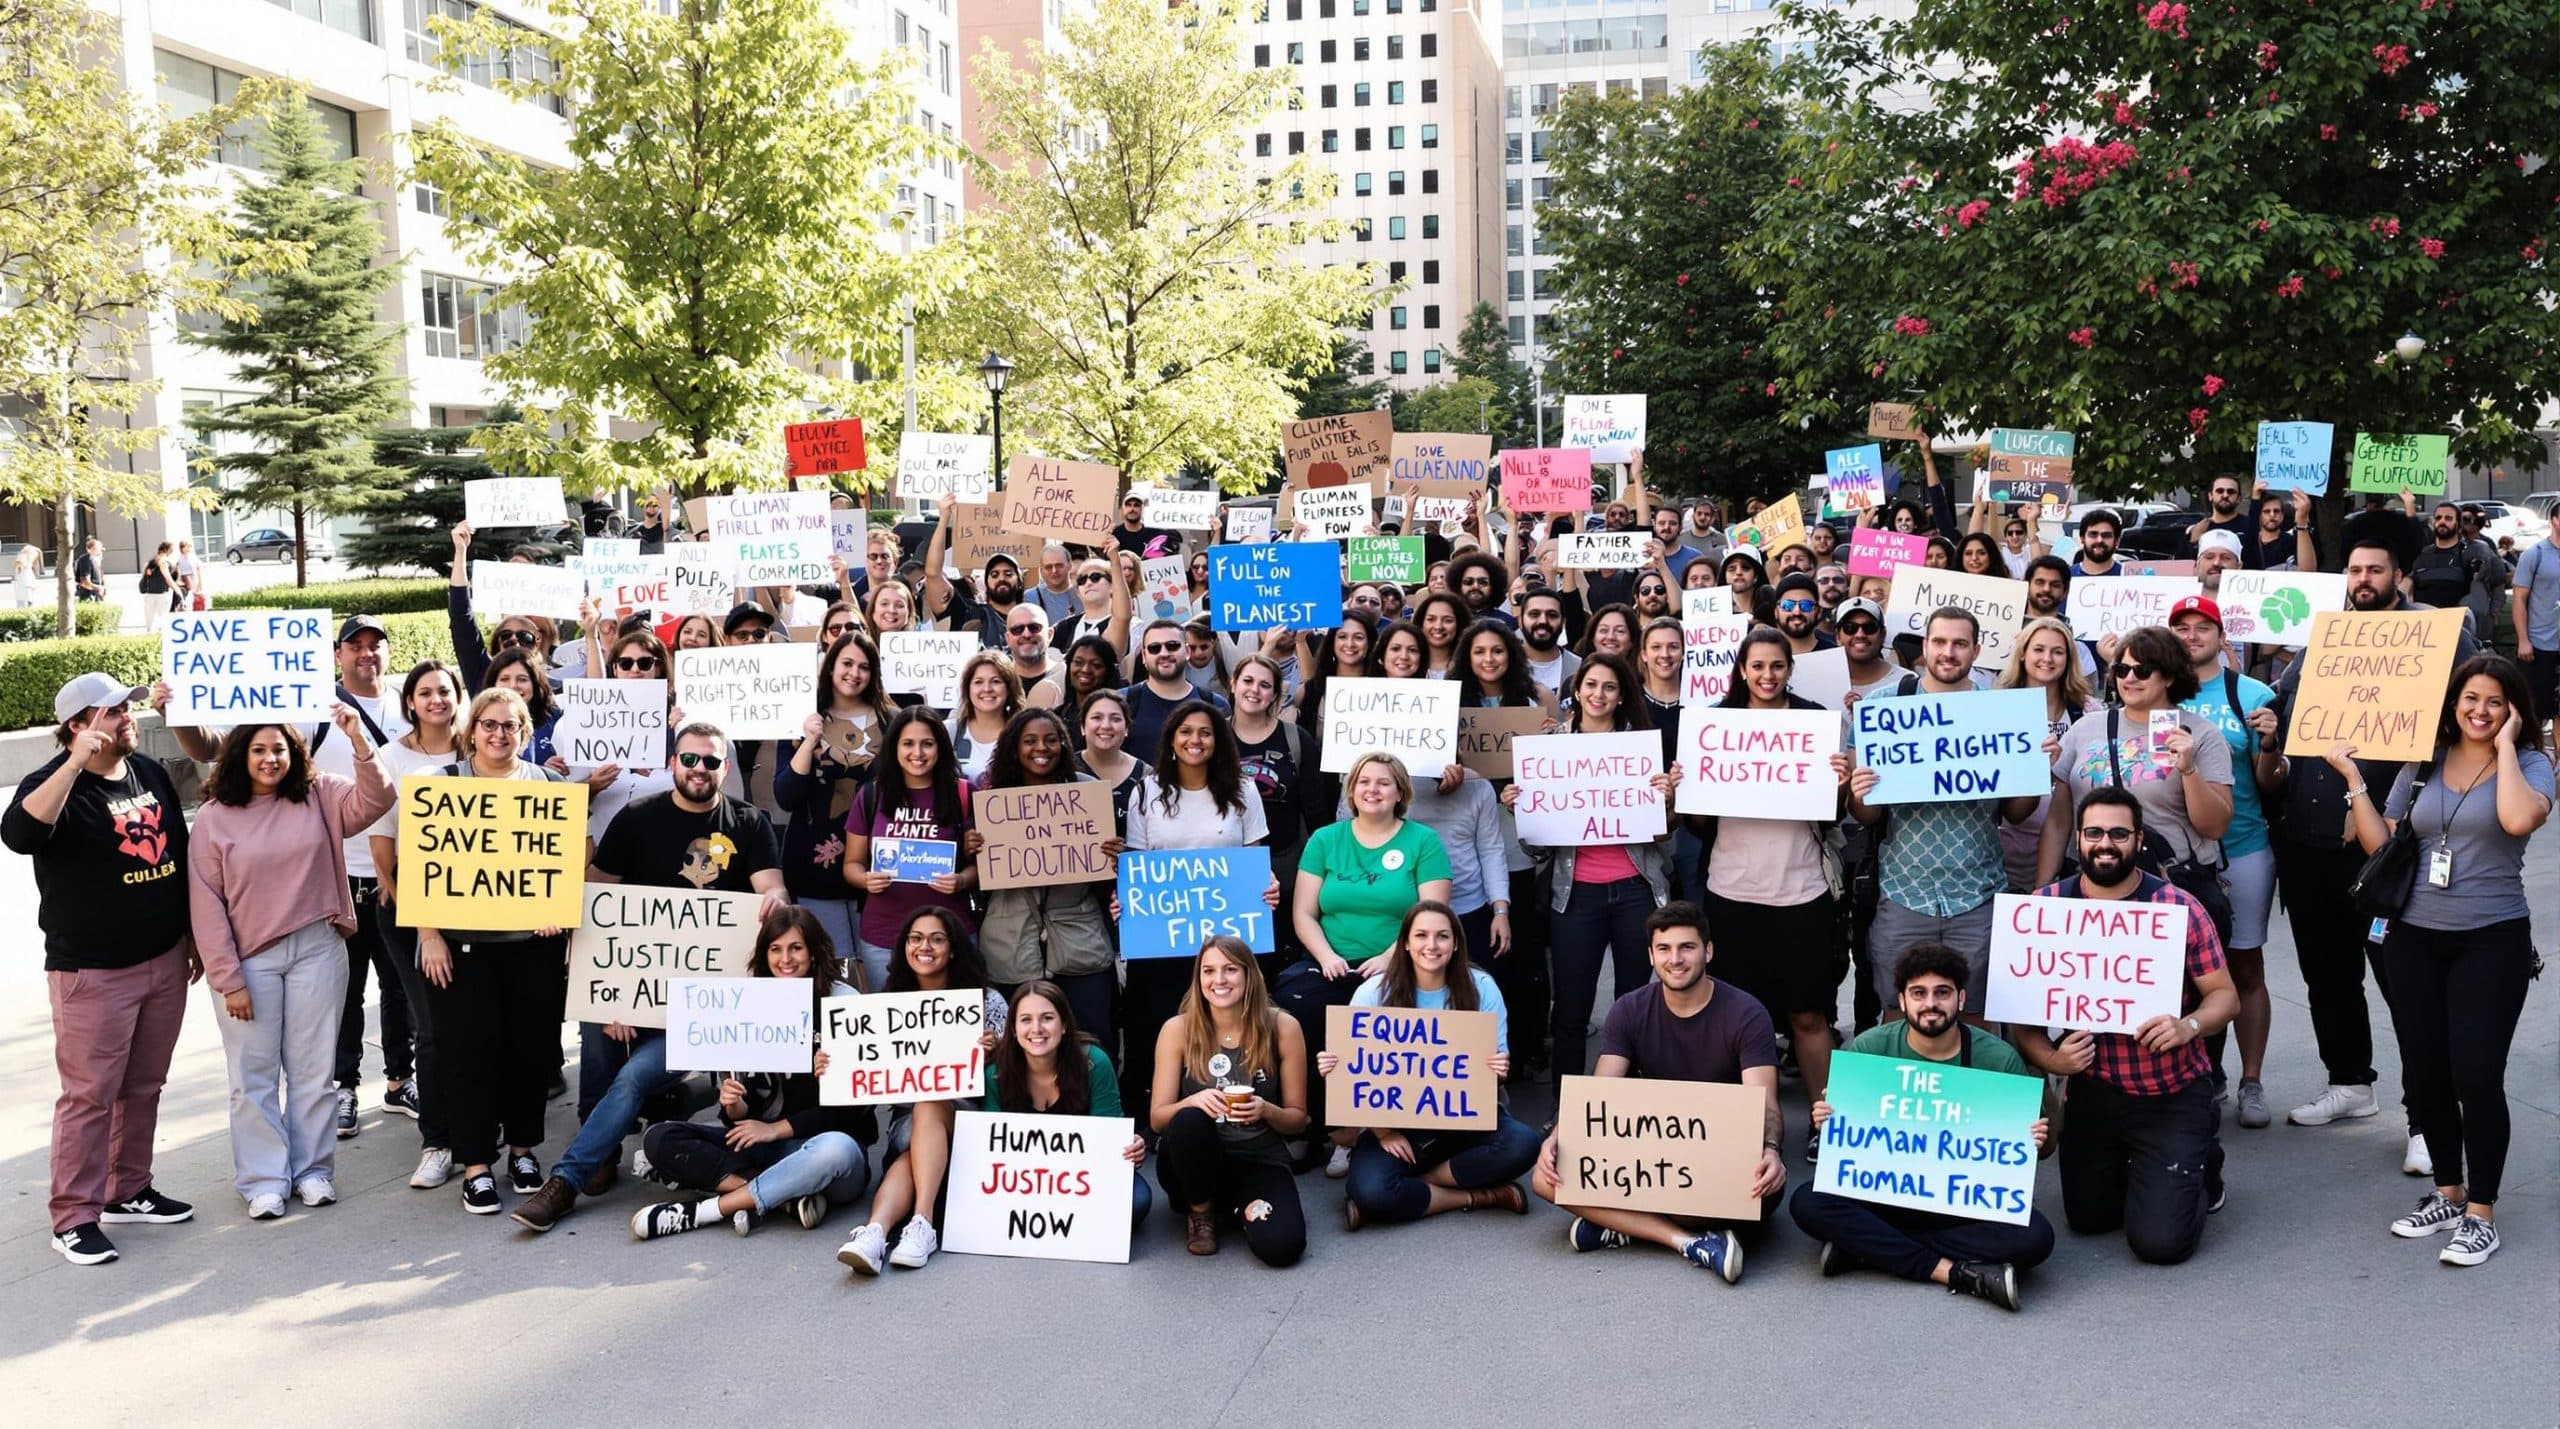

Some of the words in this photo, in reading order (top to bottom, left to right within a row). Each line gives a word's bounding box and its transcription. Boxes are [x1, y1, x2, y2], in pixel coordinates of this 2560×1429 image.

[1027, 463, 1068, 482] ALL
[2022, 460, 2049, 478] THE
[1325, 522, 1351, 535] FOW
[1576, 535, 1632, 549] FATHER
[1216, 555, 1264, 582] FULL
[1270, 565, 1291, 579] ON
[1252, 547, 1278, 562] WE
[1371, 564, 1409, 580] NOW
[1256, 584, 1282, 597] THE
[1223, 602, 1318, 625] PLANEST
[171, 619, 249, 643] SAVE
[269, 617, 322, 639] FOR
[889, 635, 960, 654] CLIMAN
[173, 651, 245, 675] FAVE
[266, 651, 317, 672] THE
[895, 661, 957, 679] RIGHTS
[191, 684, 318, 710] PLANET.
[685, 682, 747, 702] RIGHTS
[753, 674, 812, 694] RIGHTS
[2348, 685, 2380, 704] FOR
[580, 710, 661, 729] JUSTICS
[730, 704, 784, 721] FIRST
[1860, 702, 1954, 734] EQUAL
[1335, 721, 1447, 751] PUSTHERS
[1699, 723, 1815, 754] CLIMATE
[1935, 732, 2032, 763] RIGHTS
[1522, 756, 1652, 781] ECLIMATED
[1699, 756, 1812, 784] RUSTICE
[1933, 769, 2000, 796] NOW
[411, 786, 498, 819] SAVE
[518, 795, 568, 821] THE
[894, 807, 932, 822] NULL
[417, 824, 498, 854] SAVE
[511, 831, 562, 856] THE
[886, 823, 939, 838] PLANTE
[1026, 824, 1052, 840] ON
[1061, 820, 1099, 836] THE
[1583, 816, 1630, 840] ALL
[424, 861, 563, 899] PLANET
[1127, 855, 1229, 886] HUMAN
[591, 891, 737, 930] CLIMATE
[1127, 886, 1228, 917] RIGHTS
[1167, 912, 1263, 949] FIRST
[2012, 902, 2170, 941] CLIMATE
[593, 936, 723, 972] JUSTICE
[2010, 947, 2156, 986] JUSTICE
[2045, 988, 2136, 1026] FIRST
[1351, 1011, 1448, 1047] EQUAL
[859, 1042, 880, 1061] IS
[1347, 1047, 1470, 1080] JUSTICE
[1896, 1065, 1942, 1095] THE
[1352, 1081, 1404, 1111] FOR
[1415, 1086, 1479, 1119] ALL
[1585, 1101, 1707, 1141] Human
[981, 1163, 1091, 1196] JUSTICS
[1580, 1156, 1694, 1196] Rights
[1948, 1175, 2027, 1213] FIRTS
[1009, 1211, 1074, 1240] NOW
